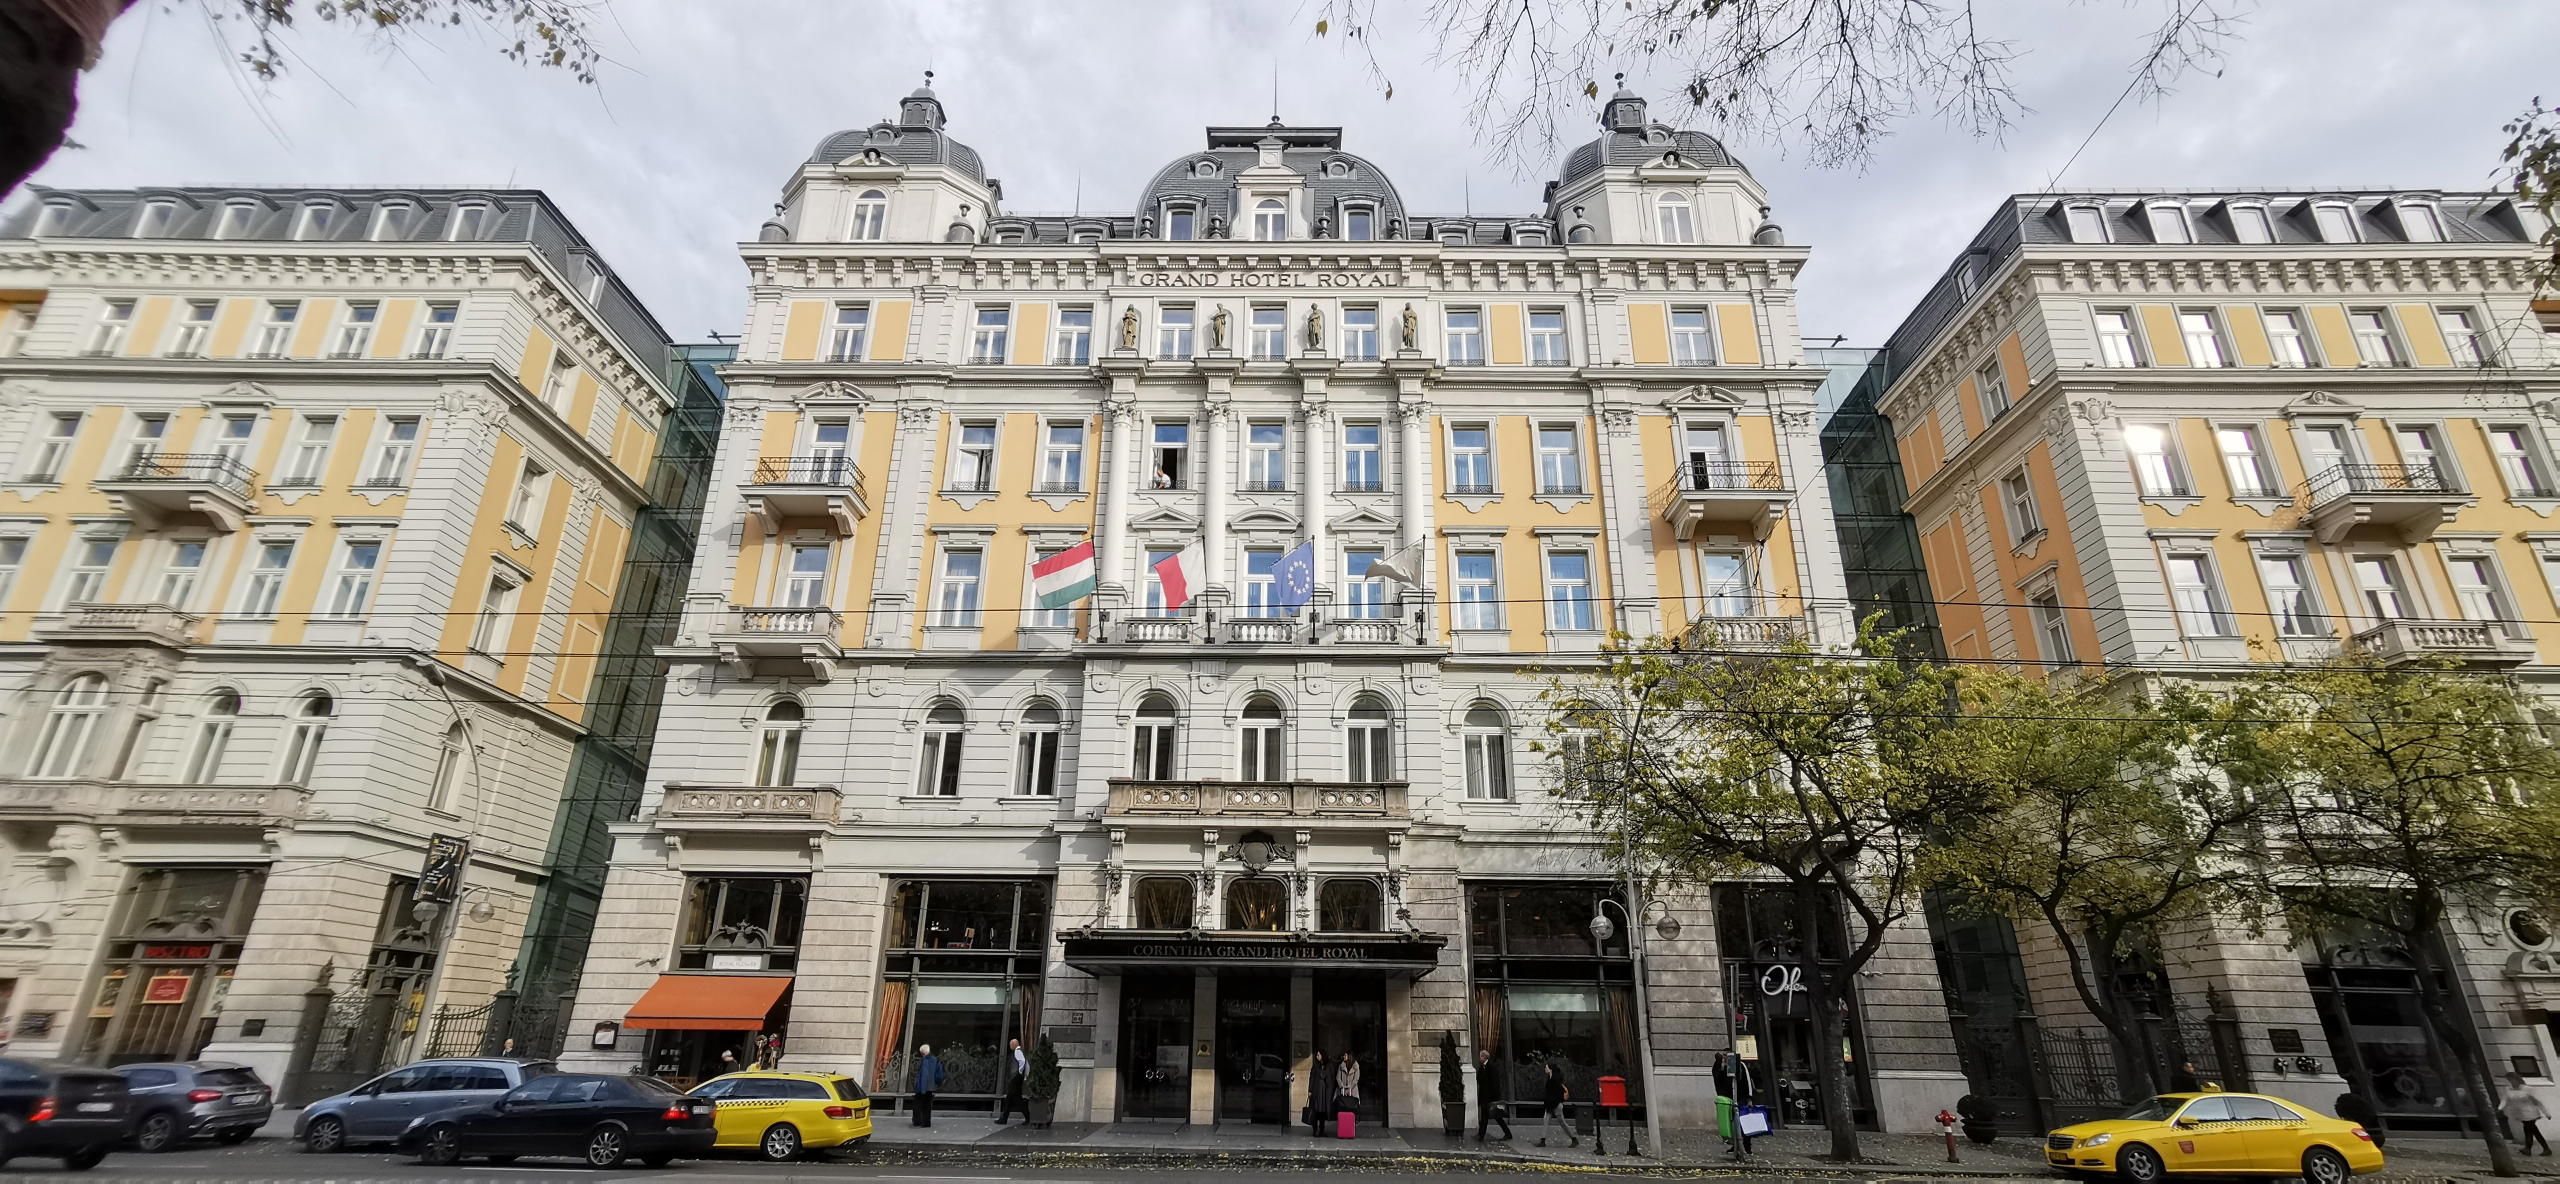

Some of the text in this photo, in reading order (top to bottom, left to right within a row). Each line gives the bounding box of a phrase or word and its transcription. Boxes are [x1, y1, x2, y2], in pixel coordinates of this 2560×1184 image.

[1140, 273, 1398, 287] GRAND HOTEL ROYAL
[1133, 945, 1368, 959] CORINTHIA GRAND HOTEL ROYAL
